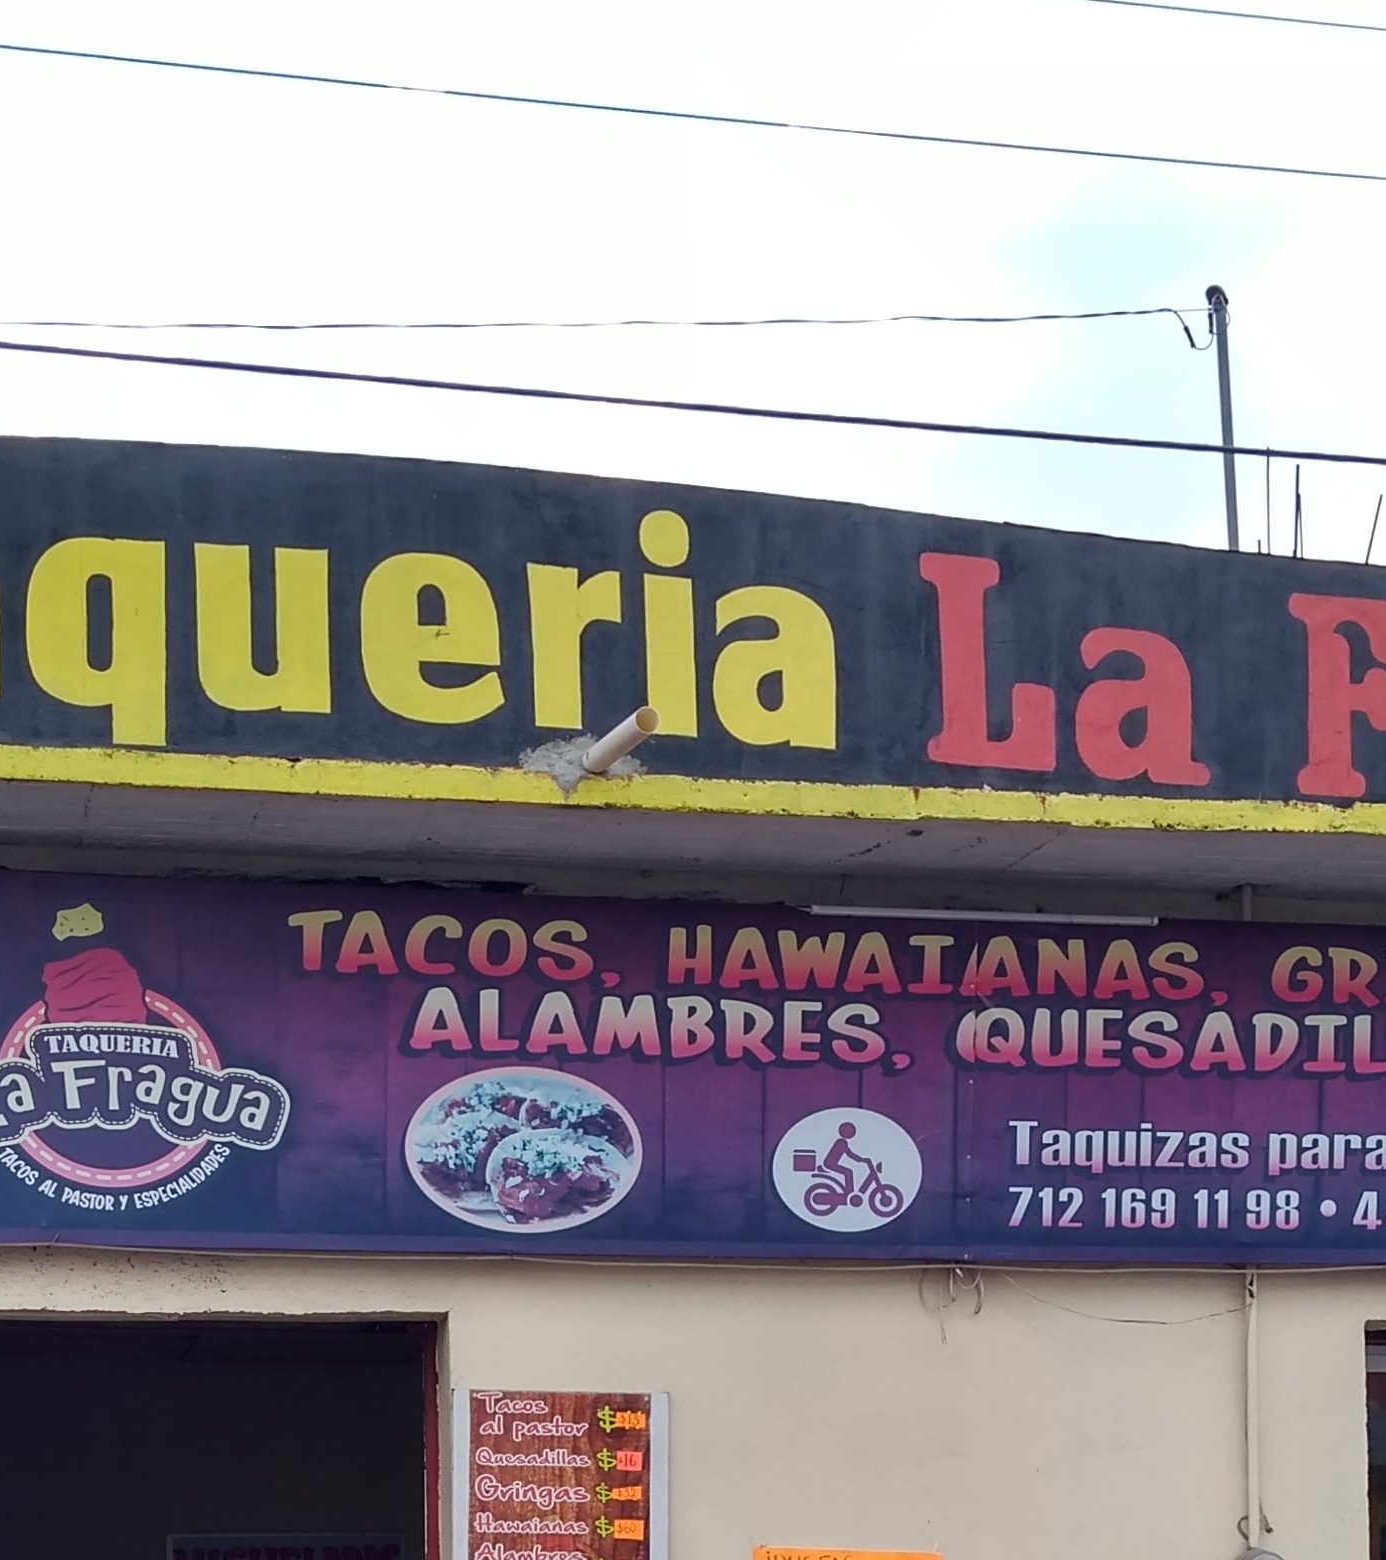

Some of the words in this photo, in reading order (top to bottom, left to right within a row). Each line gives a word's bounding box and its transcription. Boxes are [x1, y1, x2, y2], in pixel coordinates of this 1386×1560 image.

[918, 550, 1210, 788] La
[289, 910, 621, 988] TACOS,
[668, 924, 1227, 1005] HAWAIANAS,
[44, 1033, 179, 1058] TAQUERIA
[411, 986, 912, 1070] ALAMBRES,
[50, 1059, 272, 1131] Fragua
[1008, 1120, 1250, 1175] Taquizas
[39, 1178, 56, 1198] AL
[61, 1186, 115, 1211] PASTOR
[120, 1194, 129, 1211] Y
[134, 1143, 232, 1210] ESPECIALIDADES
[1008, 1186, 1083, 1228] 712
[1101, 1187, 1175, 1229] 169
[1193, 1188, 1229, 1230] 11
[1246, 1189, 1300, 1230] 98
[476, 1391, 548, 1414] Tacos
[480, 1415, 503, 1435] al
[513, 1415, 589, 1441] pastor
[475, 1447, 591, 1467] Quesadillas
[475, 1473, 590, 1510] Gringas
[474, 1512, 589, 1535] Hawaianas
